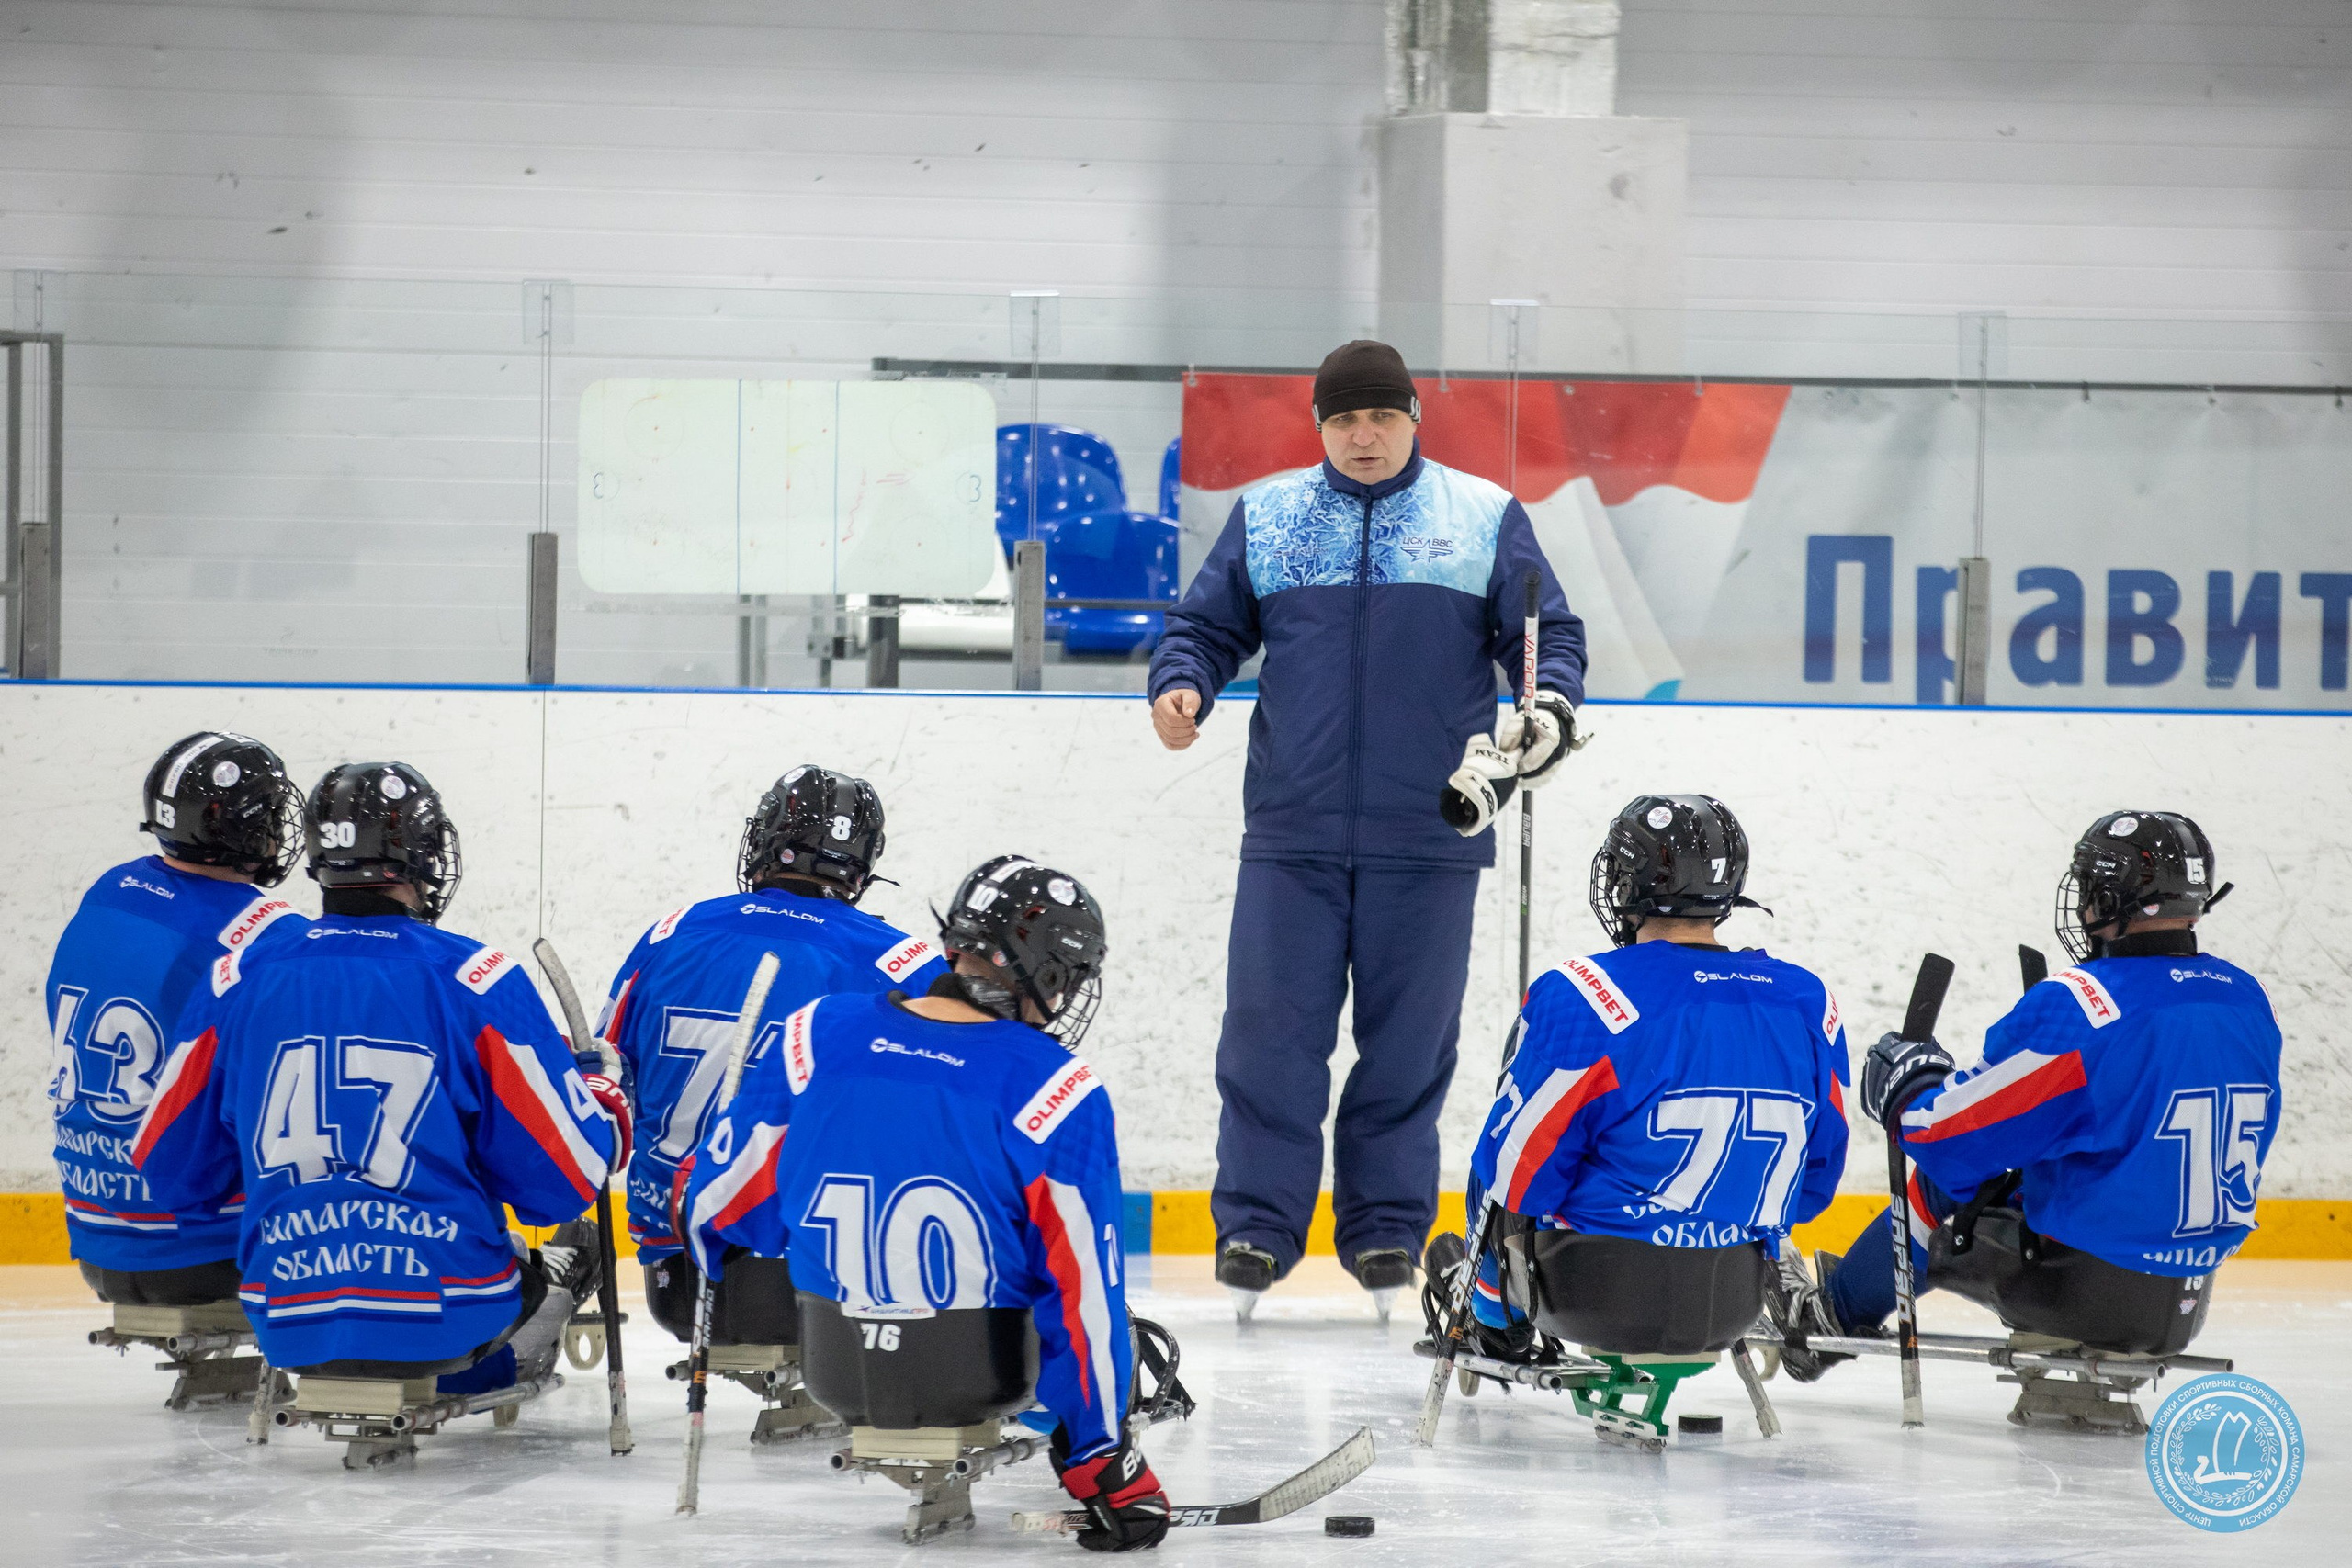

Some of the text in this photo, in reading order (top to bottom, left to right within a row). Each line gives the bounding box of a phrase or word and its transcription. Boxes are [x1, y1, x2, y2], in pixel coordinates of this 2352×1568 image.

[320, 821, 356, 849] 30
[831, 815, 852, 840] 8
[1619, 846, 1635, 860] CCM
[1711, 857, 1726, 884] 7
[2185, 857, 2206, 885] 15
[967, 883, 1000, 912] 10
[754, 905, 825, 925] SLALOM
[322, 927, 399, 940] SLALOM
[468, 951, 507, 985] OLIMP
[887, 942, 929, 974] OLIMP
[1562, 959, 1629, 1023] OLIMPBET
[1707, 973, 1773, 984] SLALOM
[2184, 970, 2233, 985] SLALOM
[888, 1043, 966, 1067] SLALOM
[252, 1034, 441, 1194] 47
[1647, 1086, 1815, 1228] 77
[2154, 1084, 2276, 1238] 15
[259, 1200, 458, 1246] САМАРСКАЯ
[799, 1173, 999, 1312] 10
[272, 1242, 430, 1282] ОБЛАСТЬ
[860, 1322, 902, 1352] 76
